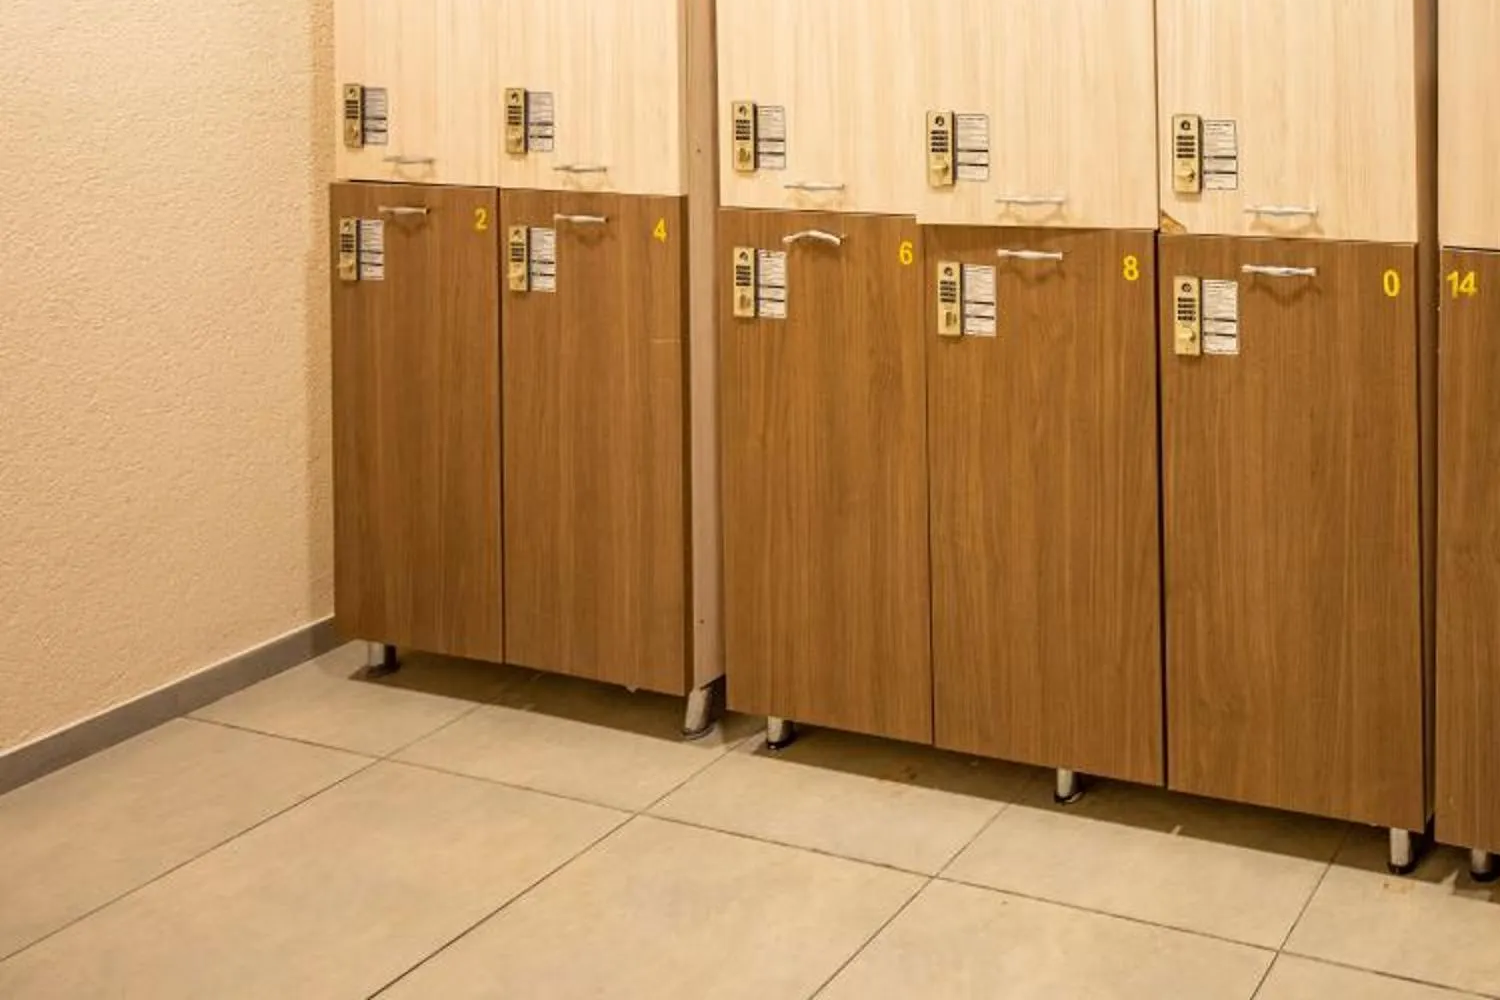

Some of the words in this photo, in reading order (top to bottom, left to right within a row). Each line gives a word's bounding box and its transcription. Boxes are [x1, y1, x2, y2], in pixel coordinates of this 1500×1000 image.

[474, 207, 488, 230] 2
[653, 216, 668, 243] 4
[899, 240, 914, 265] 6
[1123, 254, 1140, 281] 8
[1383, 268, 1400, 297] 0
[1446, 270, 1477, 298] 14
